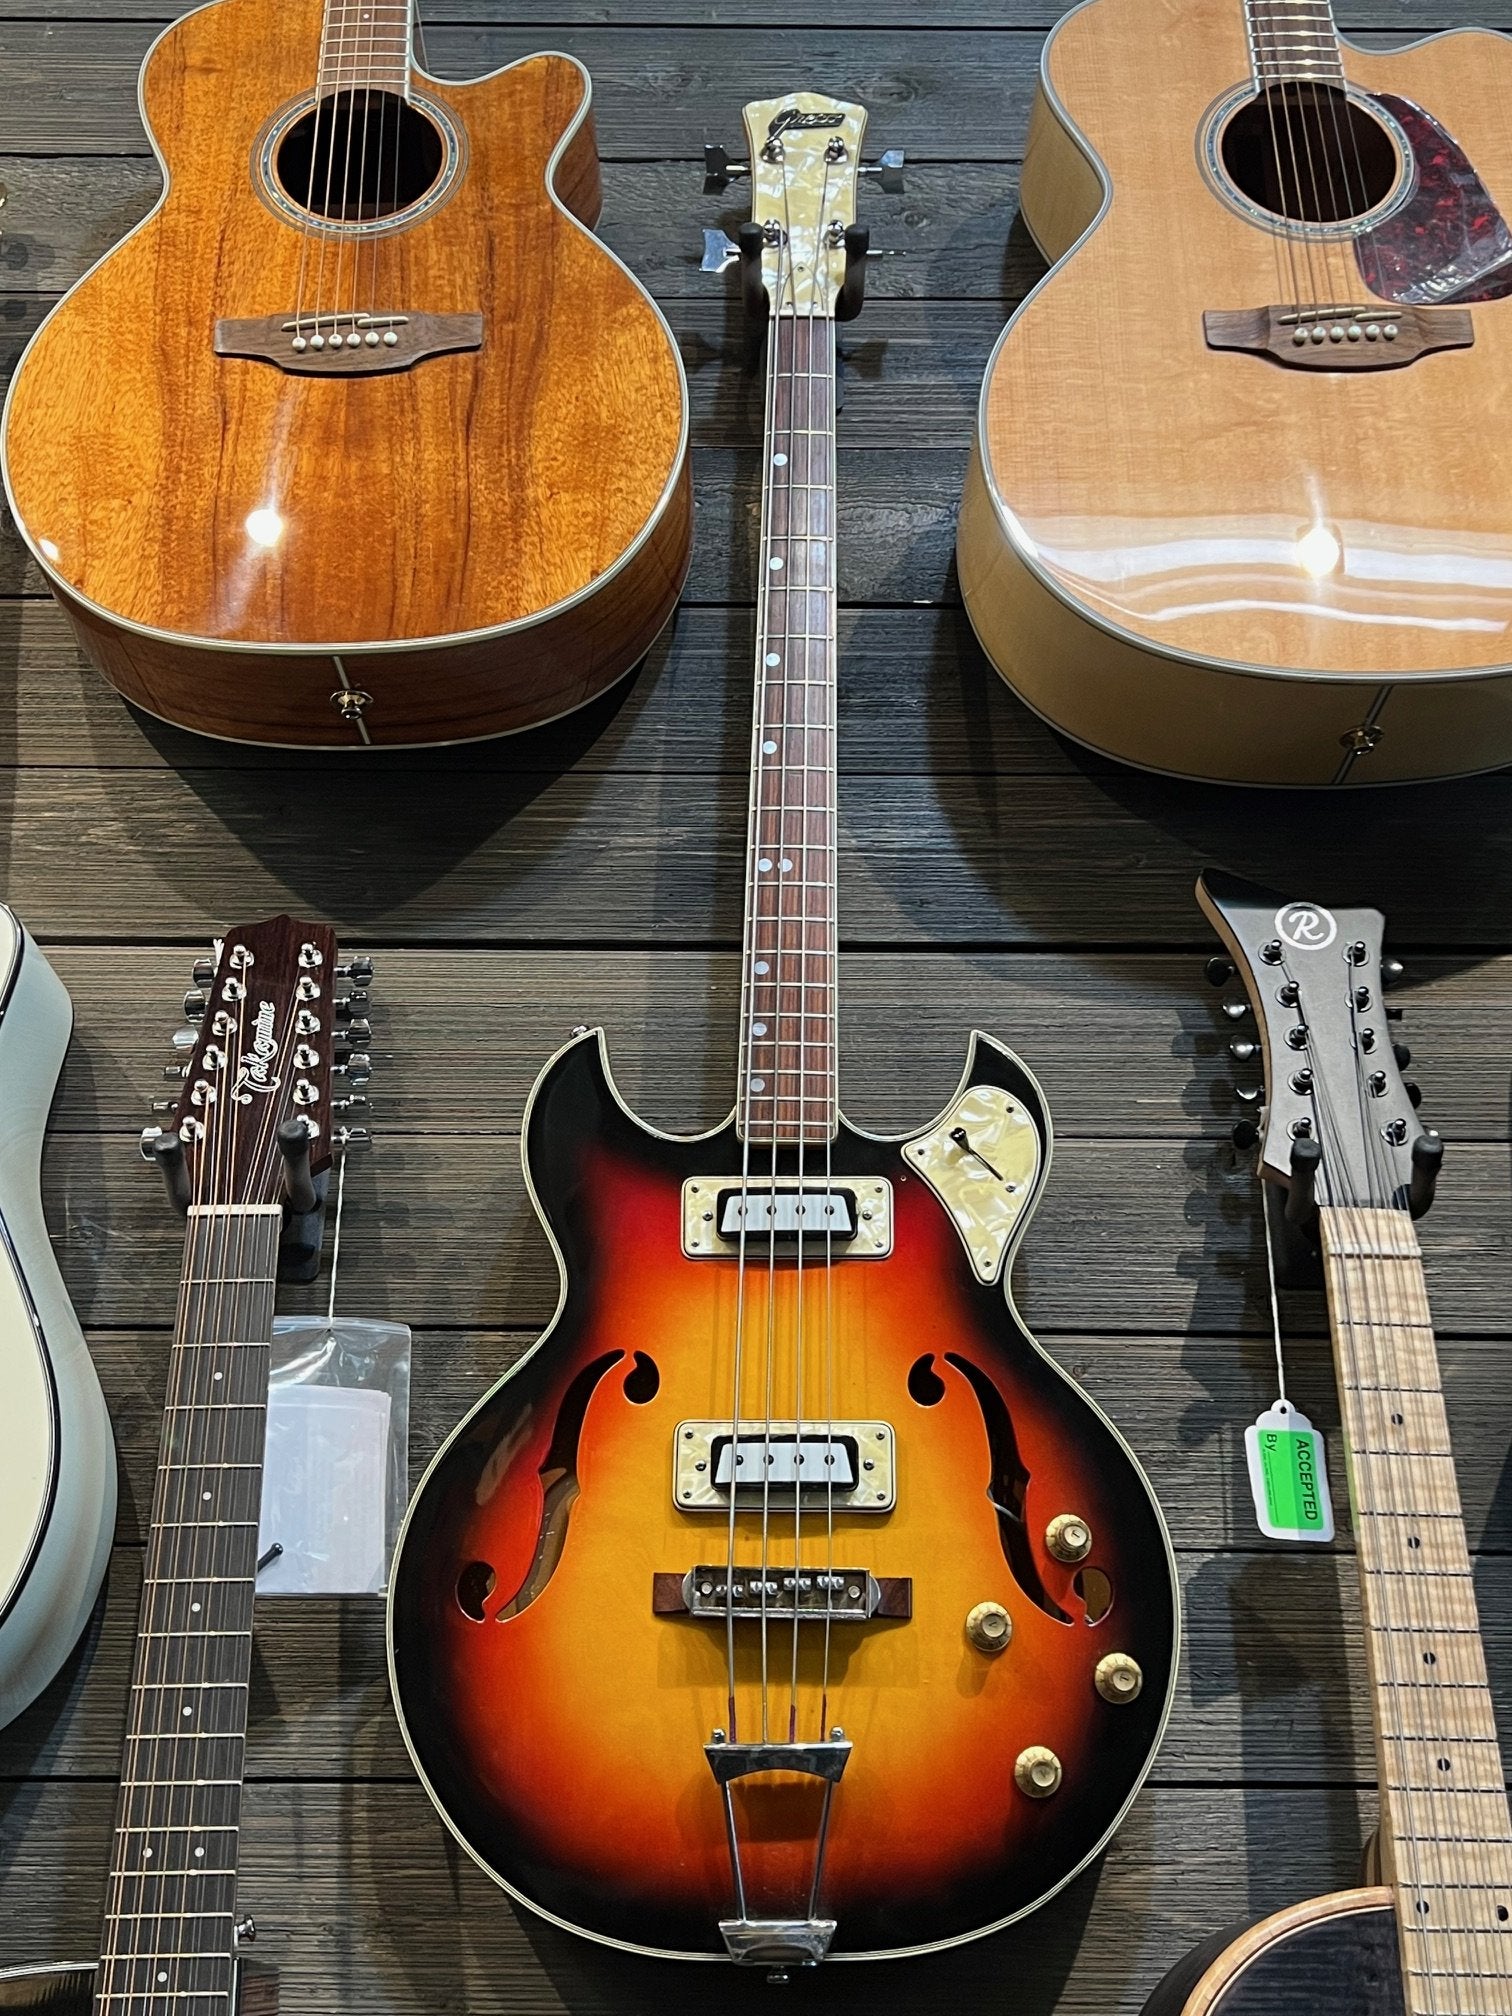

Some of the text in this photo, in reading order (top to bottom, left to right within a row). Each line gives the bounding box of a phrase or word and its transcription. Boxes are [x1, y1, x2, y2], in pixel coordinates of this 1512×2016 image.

[1288, 910, 1325, 940] R
[230, 1000, 282, 1105] Takamine
[1264, 1433, 1278, 1452] By
[1295, 1438, 1318, 1521] ACCEPTED
